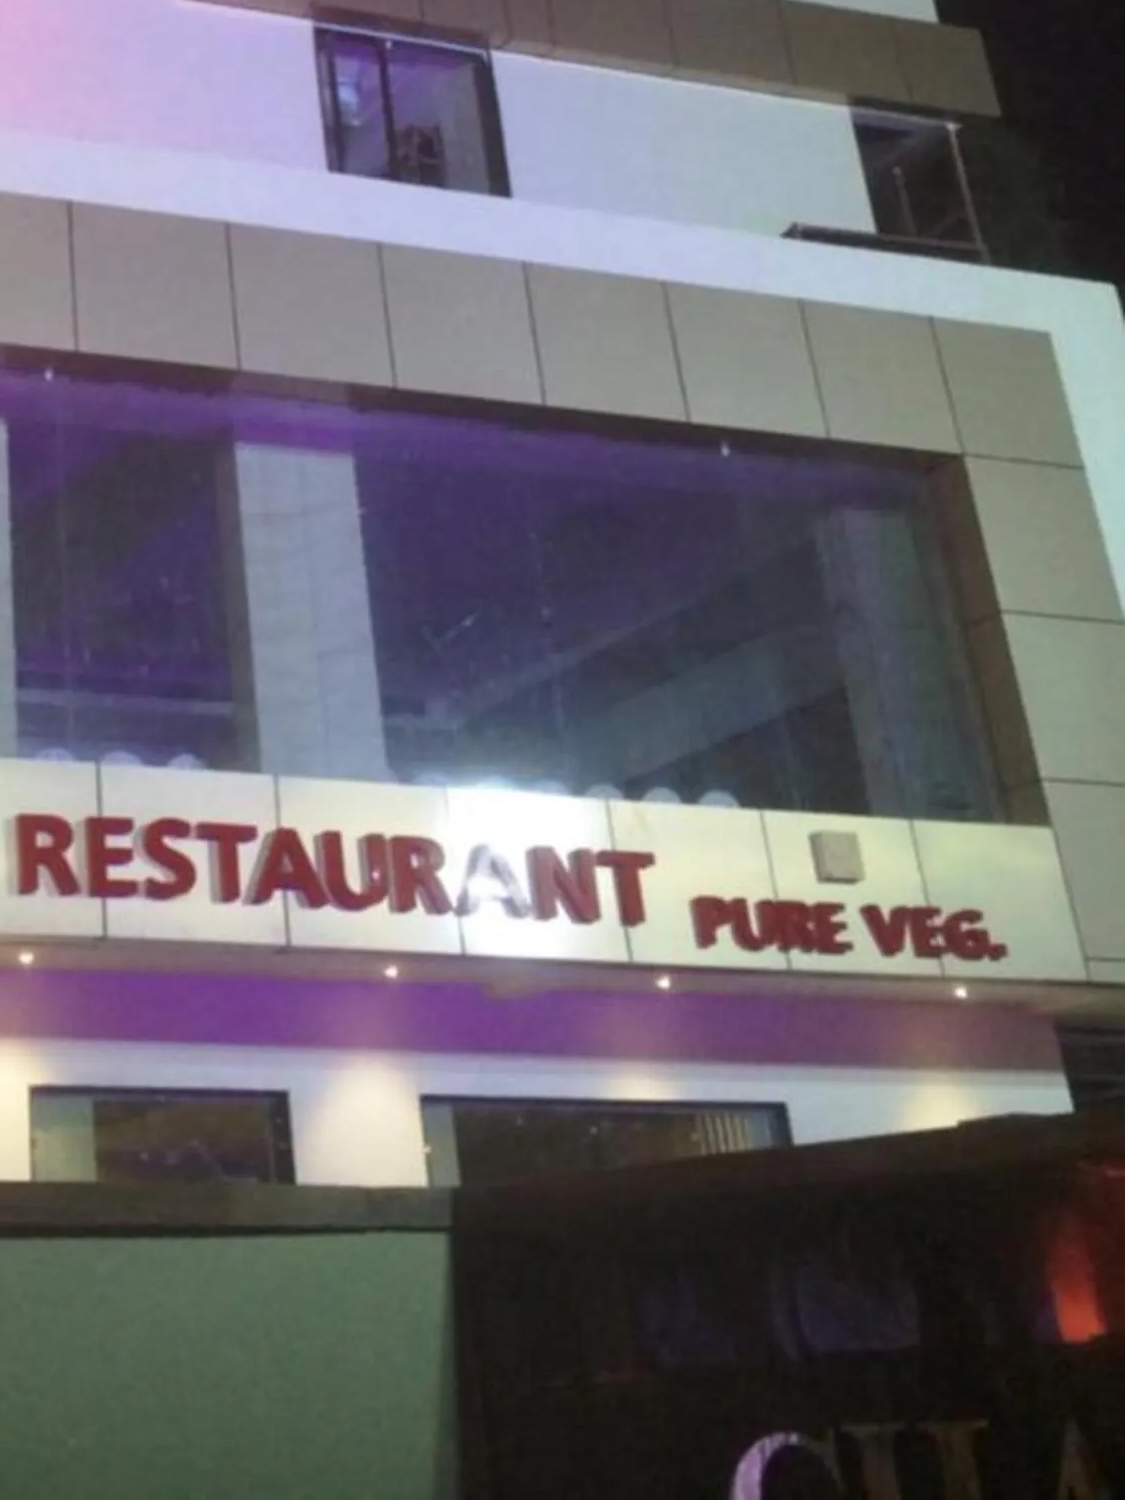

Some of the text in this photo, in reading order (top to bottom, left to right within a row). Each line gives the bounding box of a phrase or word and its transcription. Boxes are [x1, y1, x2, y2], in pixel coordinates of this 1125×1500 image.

[13, 813, 656, 927] RESTAURANT
[690, 896, 1007, 961] PURE VEG.
